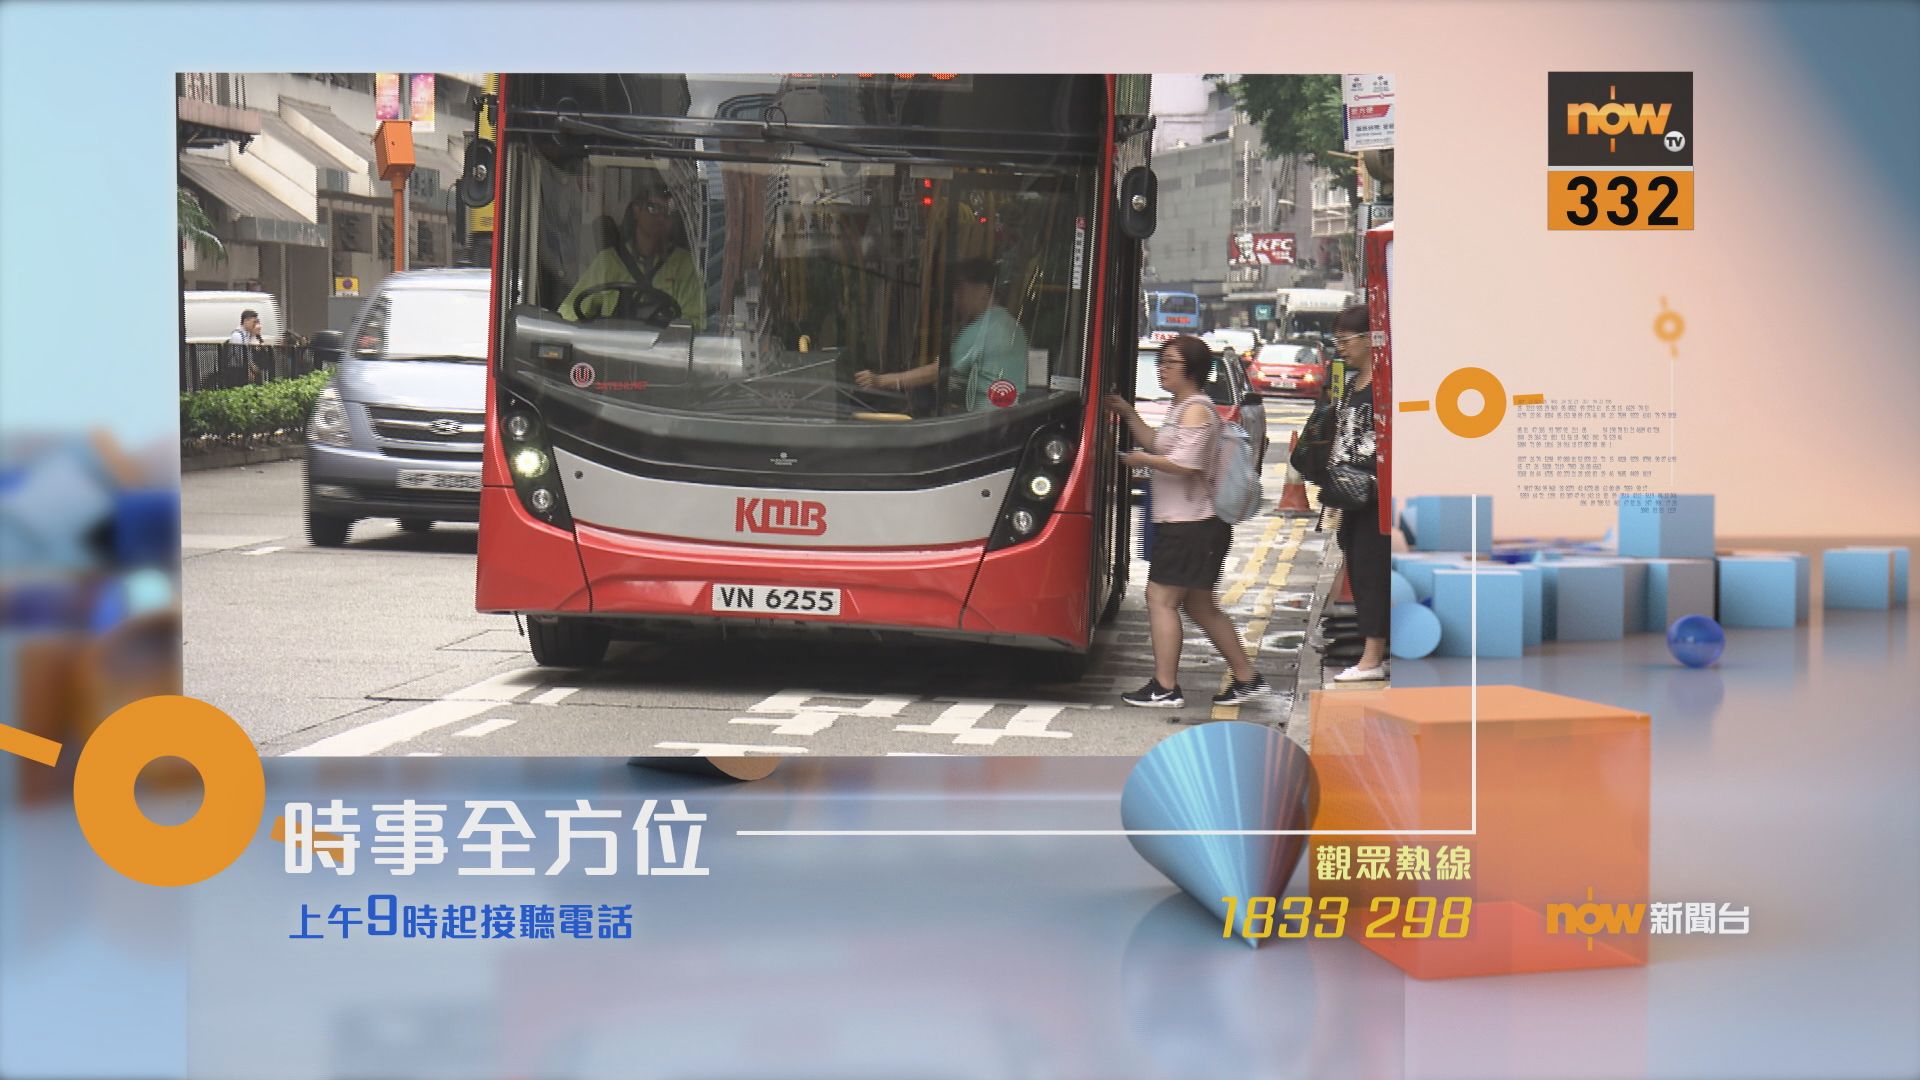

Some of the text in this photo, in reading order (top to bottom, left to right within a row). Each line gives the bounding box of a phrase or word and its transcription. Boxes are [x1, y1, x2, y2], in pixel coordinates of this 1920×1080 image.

[1256, 238, 1293, 250] KFC
[735, 497, 828, 536] KMB
[720, 586, 834, 611] VN 6255
